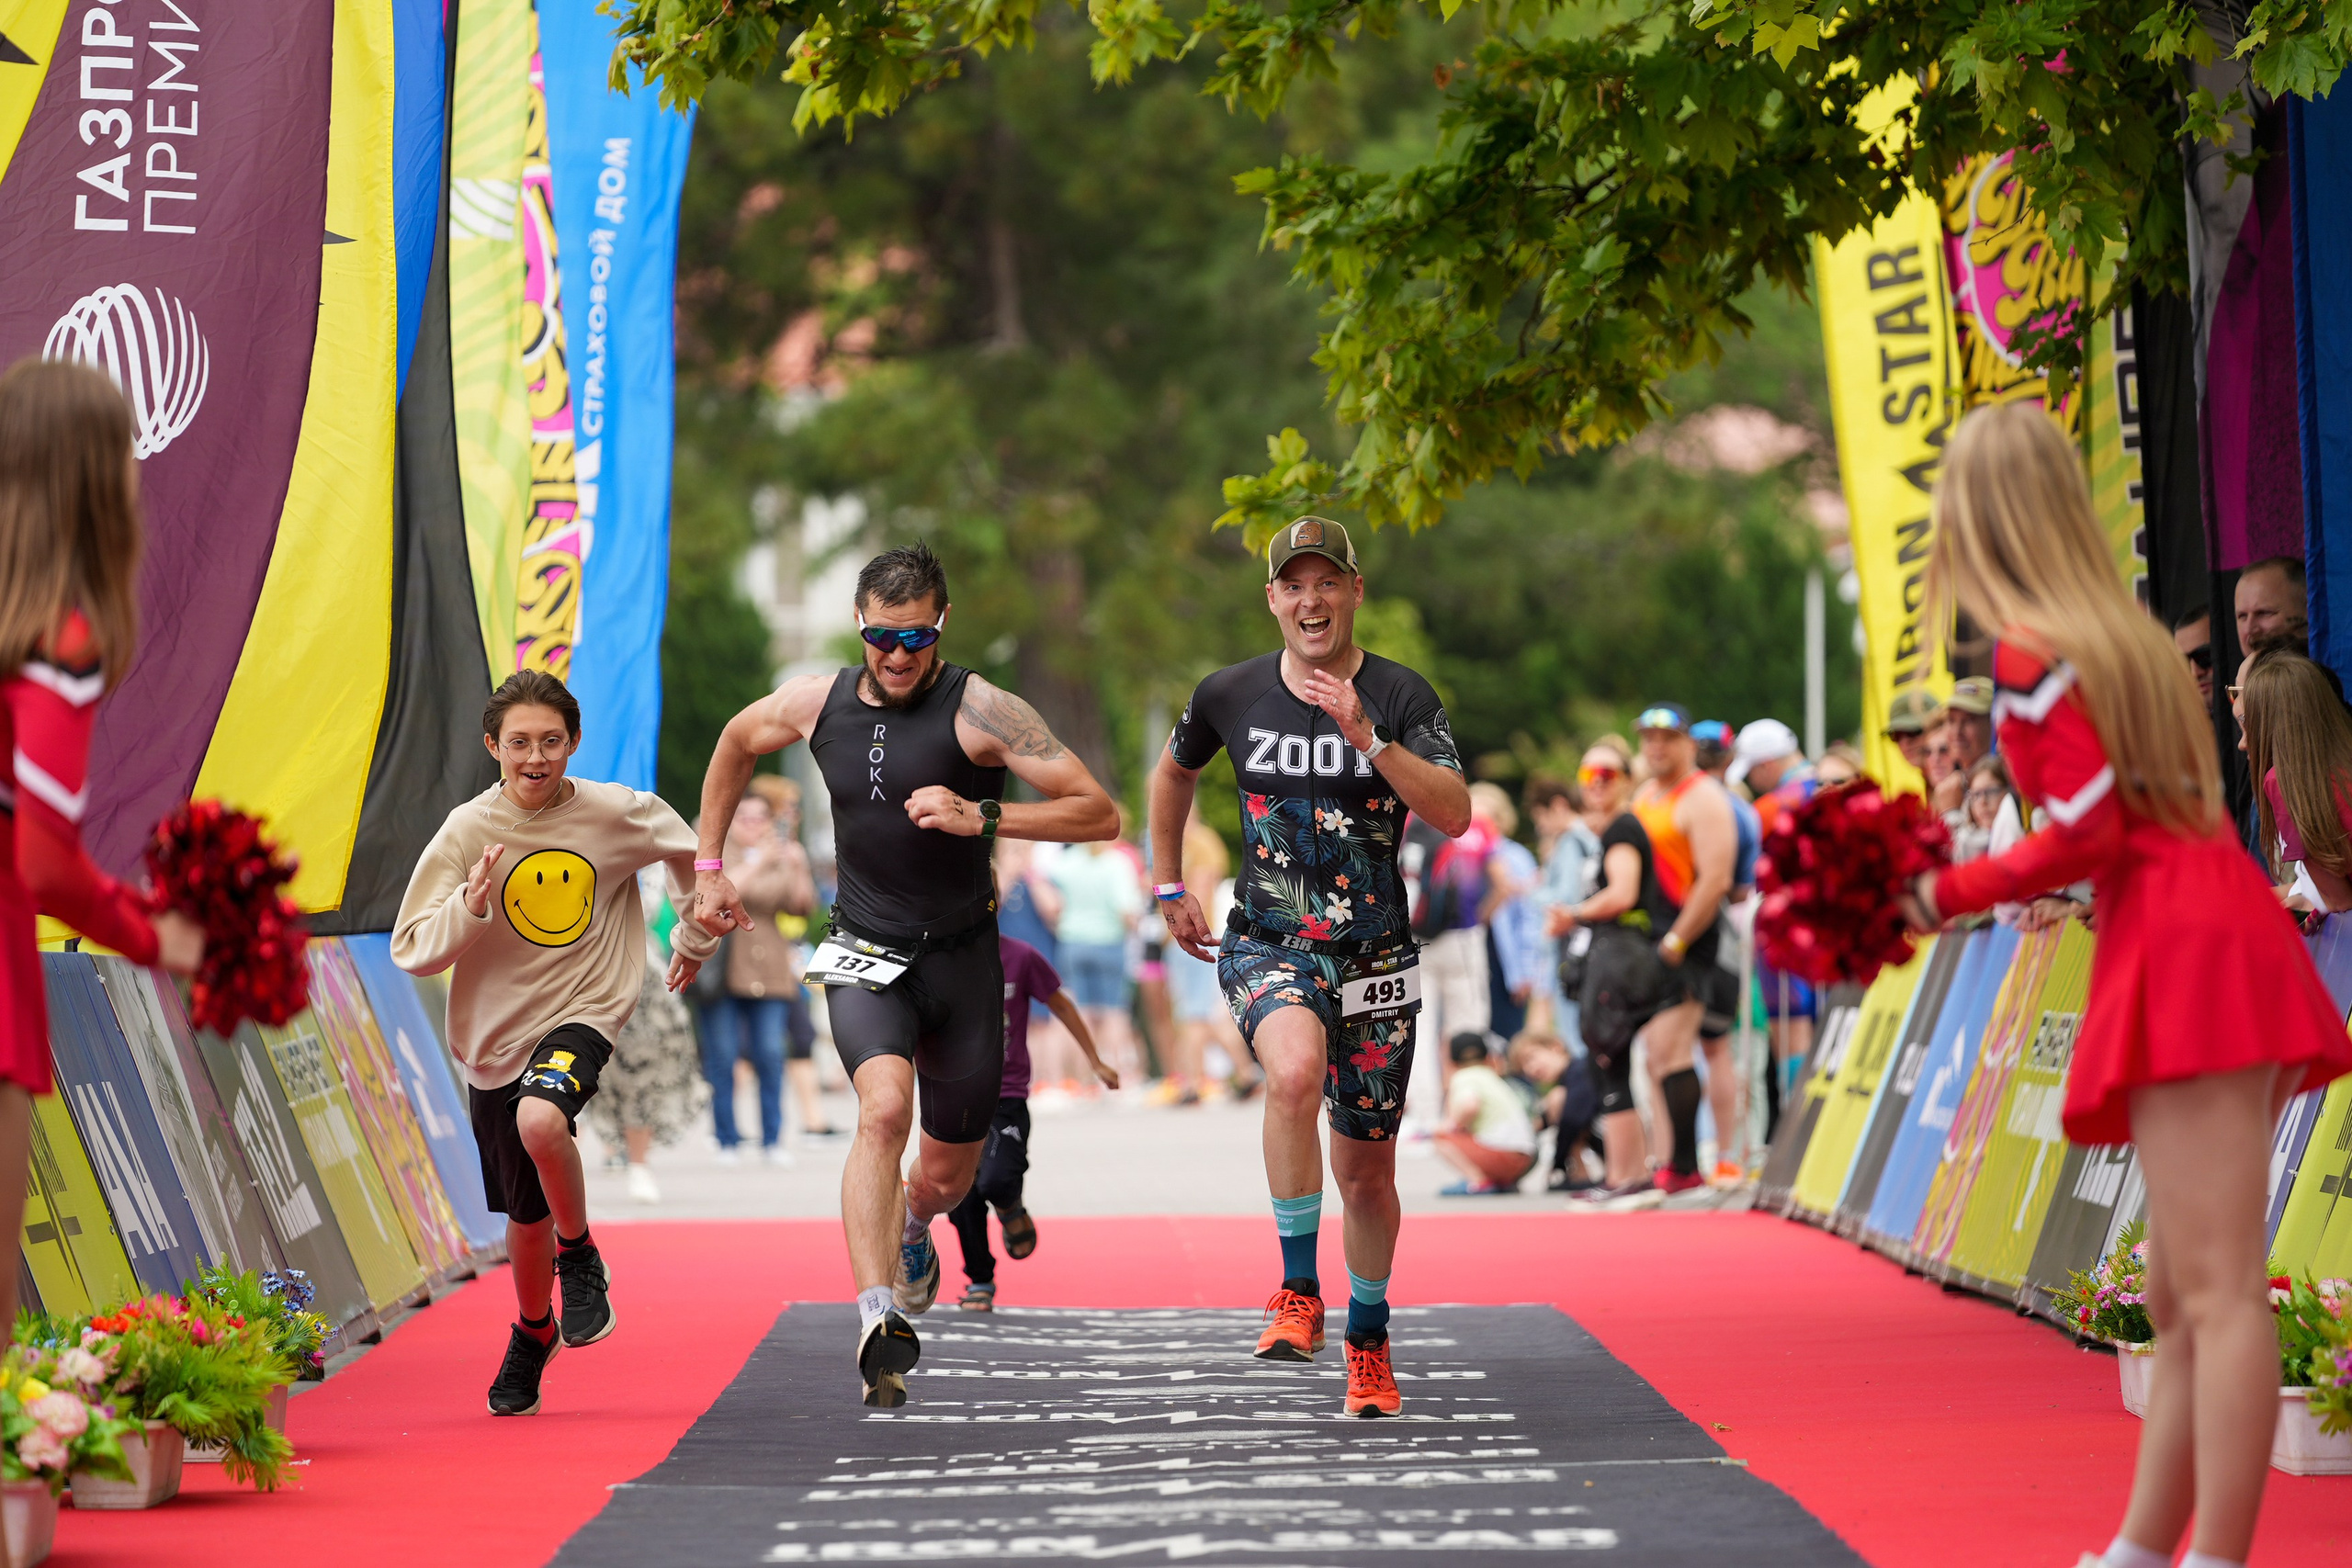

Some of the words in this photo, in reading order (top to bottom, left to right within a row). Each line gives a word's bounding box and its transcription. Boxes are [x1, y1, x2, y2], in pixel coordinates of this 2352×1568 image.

[74, 0, 134, 231] ГАЗПР
[594, 137, 632, 224] ДОМ
[581, 228, 617, 437] СТРАХОВОЙ
[1867, 242, 1931, 428] STAR
[834, 954, 877, 974] 137
[1363, 976, 1406, 1006] 493
[1371, 1009, 1399, 1019] DMITRIY
